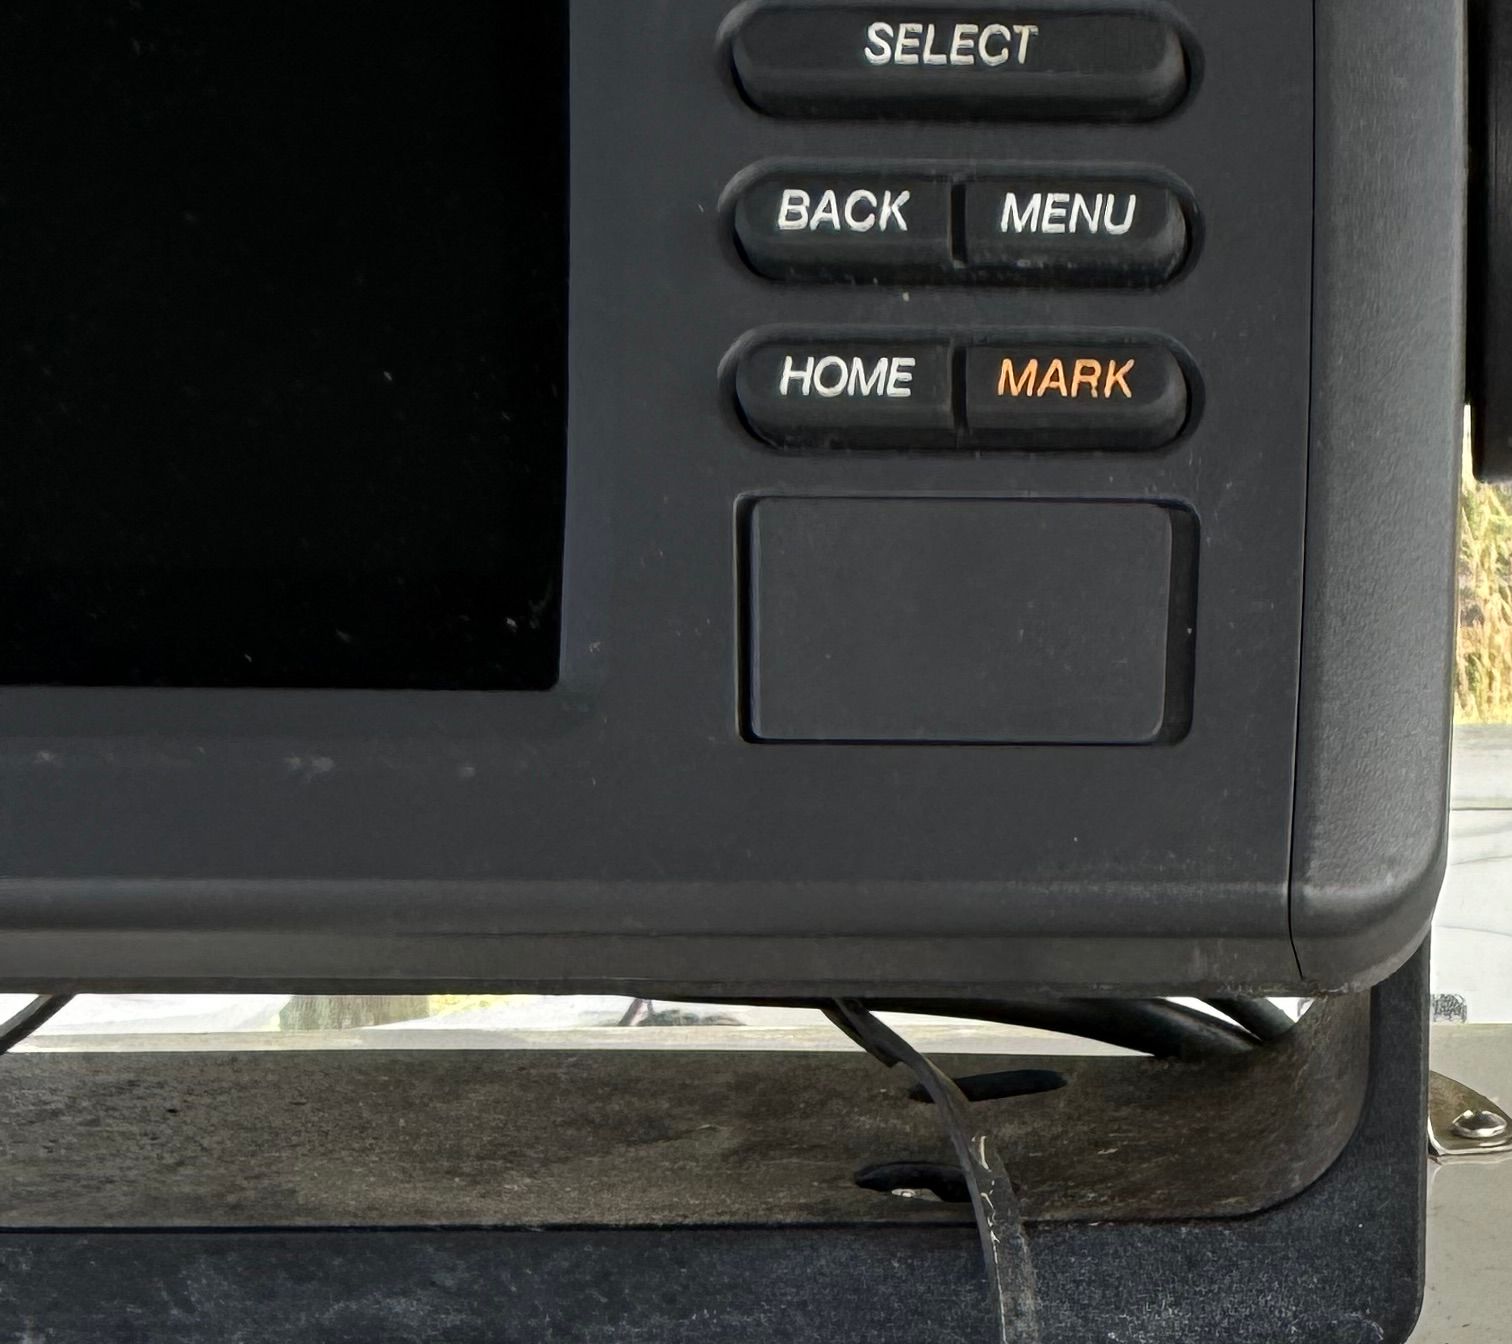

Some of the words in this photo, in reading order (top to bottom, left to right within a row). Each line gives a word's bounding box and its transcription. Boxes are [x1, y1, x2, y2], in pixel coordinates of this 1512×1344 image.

[864, 22, 1039, 65] SELECT
[777, 189, 911, 232] BACK
[1000, 192, 1136, 234] MENU
[779, 355, 915, 397] HOME
[997, 359, 1135, 398] MARK
